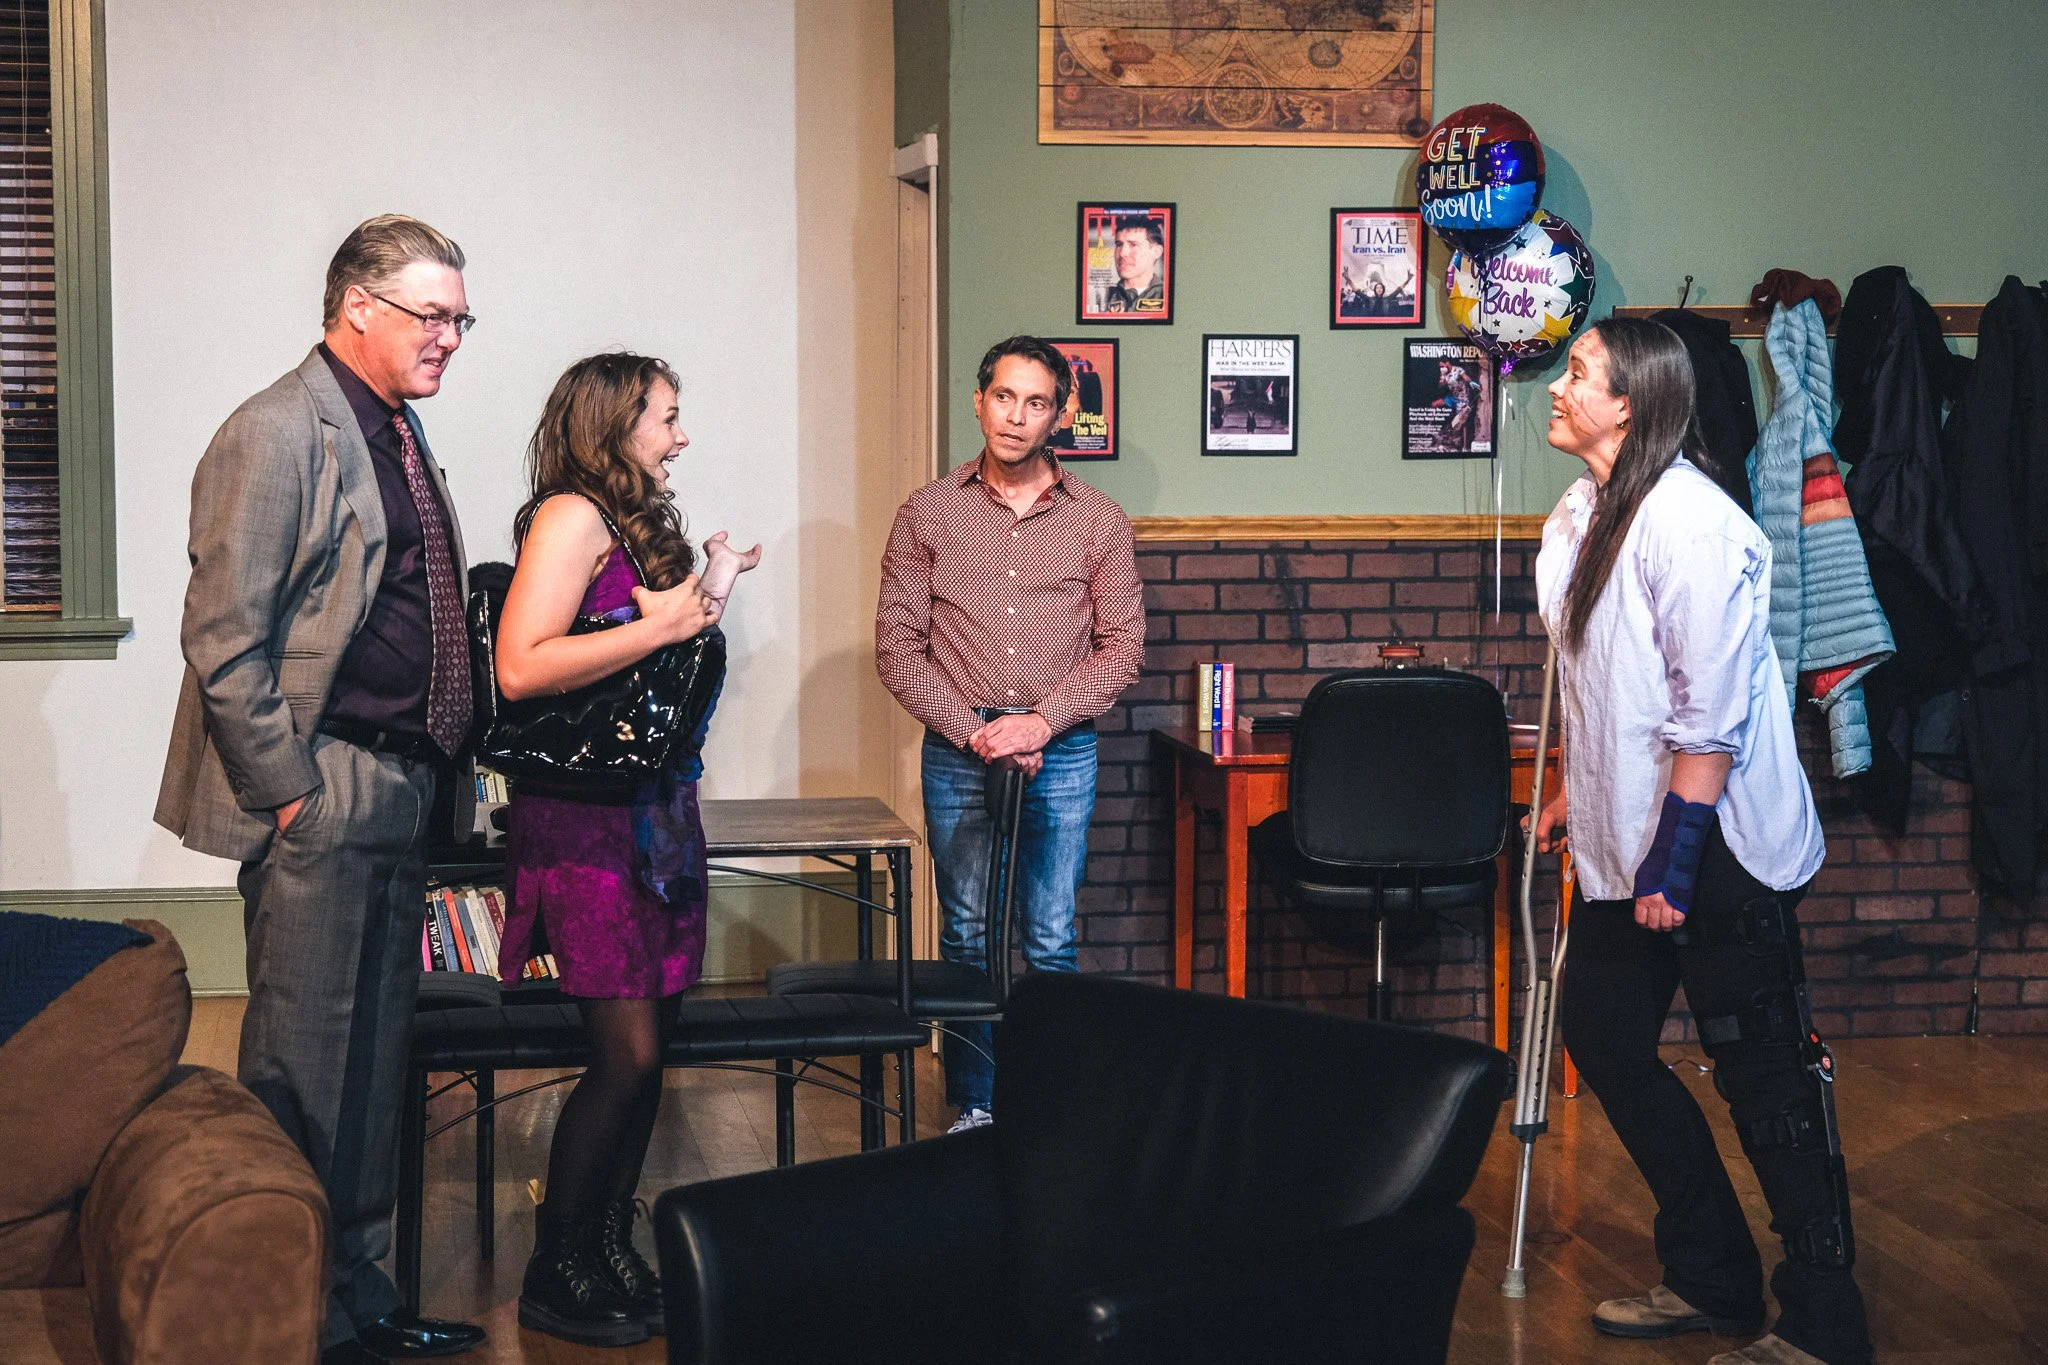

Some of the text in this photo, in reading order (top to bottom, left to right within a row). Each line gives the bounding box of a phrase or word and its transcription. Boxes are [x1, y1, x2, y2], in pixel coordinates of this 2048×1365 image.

[1427, 126, 1486, 162] GET
[1429, 162, 1481, 189] WELL
[1421, 184, 1493, 225] Soon!
[1351, 227, 1408, 245] TIME
[1352, 245, 1406, 254] Iran vs. Iran
[1483, 281, 1537, 318] Back
[1409, 345, 1463, 358] WASHINGTON
[1075, 412, 1105, 425] Lifting
[1072, 424, 1107, 436] The Veil
[1214, 670, 1222, 686] Right
[428, 919, 443, 956] TWEAK
